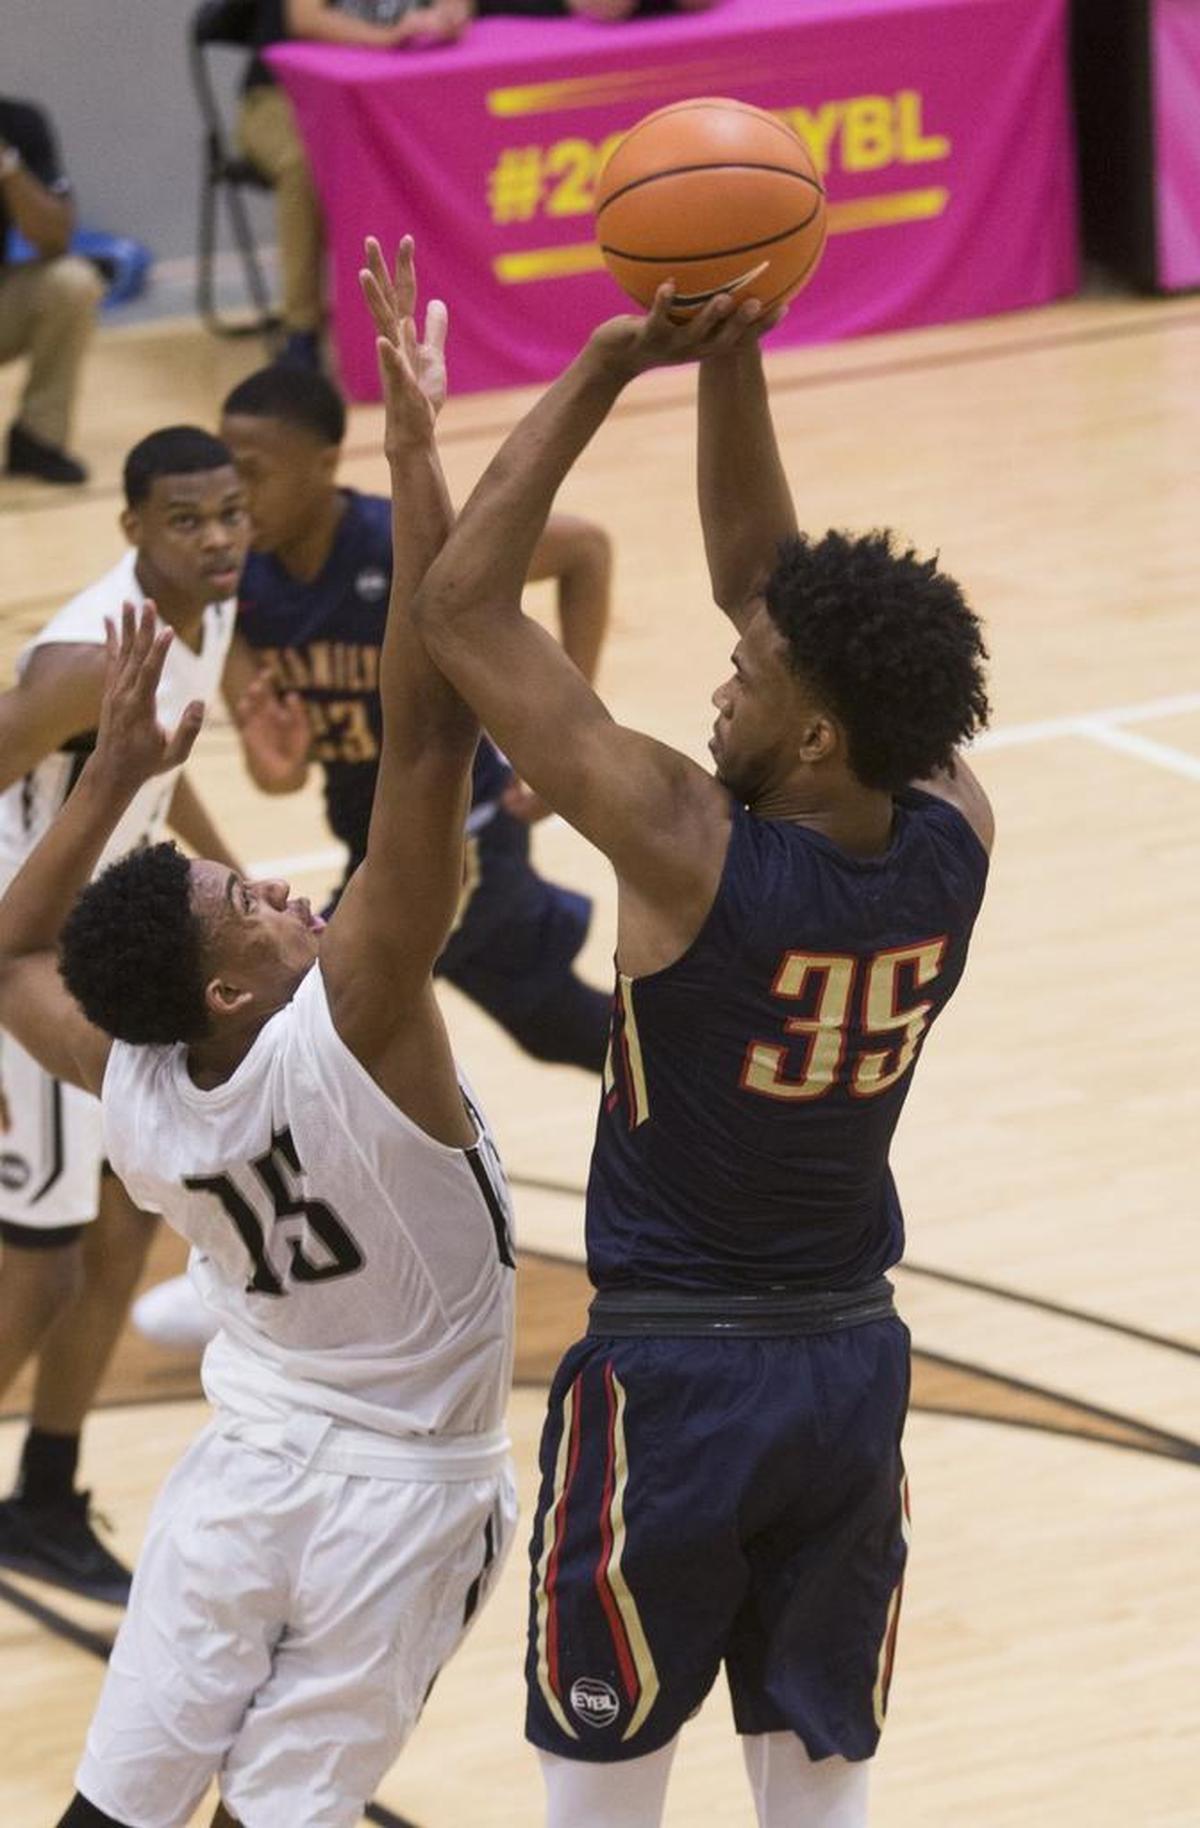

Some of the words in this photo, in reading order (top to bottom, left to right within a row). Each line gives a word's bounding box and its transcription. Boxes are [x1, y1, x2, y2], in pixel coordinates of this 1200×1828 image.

[772, 90, 950, 174] YBL
[739, 934, 948, 1101] 35
[180, 1123, 367, 1297] 15
[571, 1691, 618, 1712] EYBL
